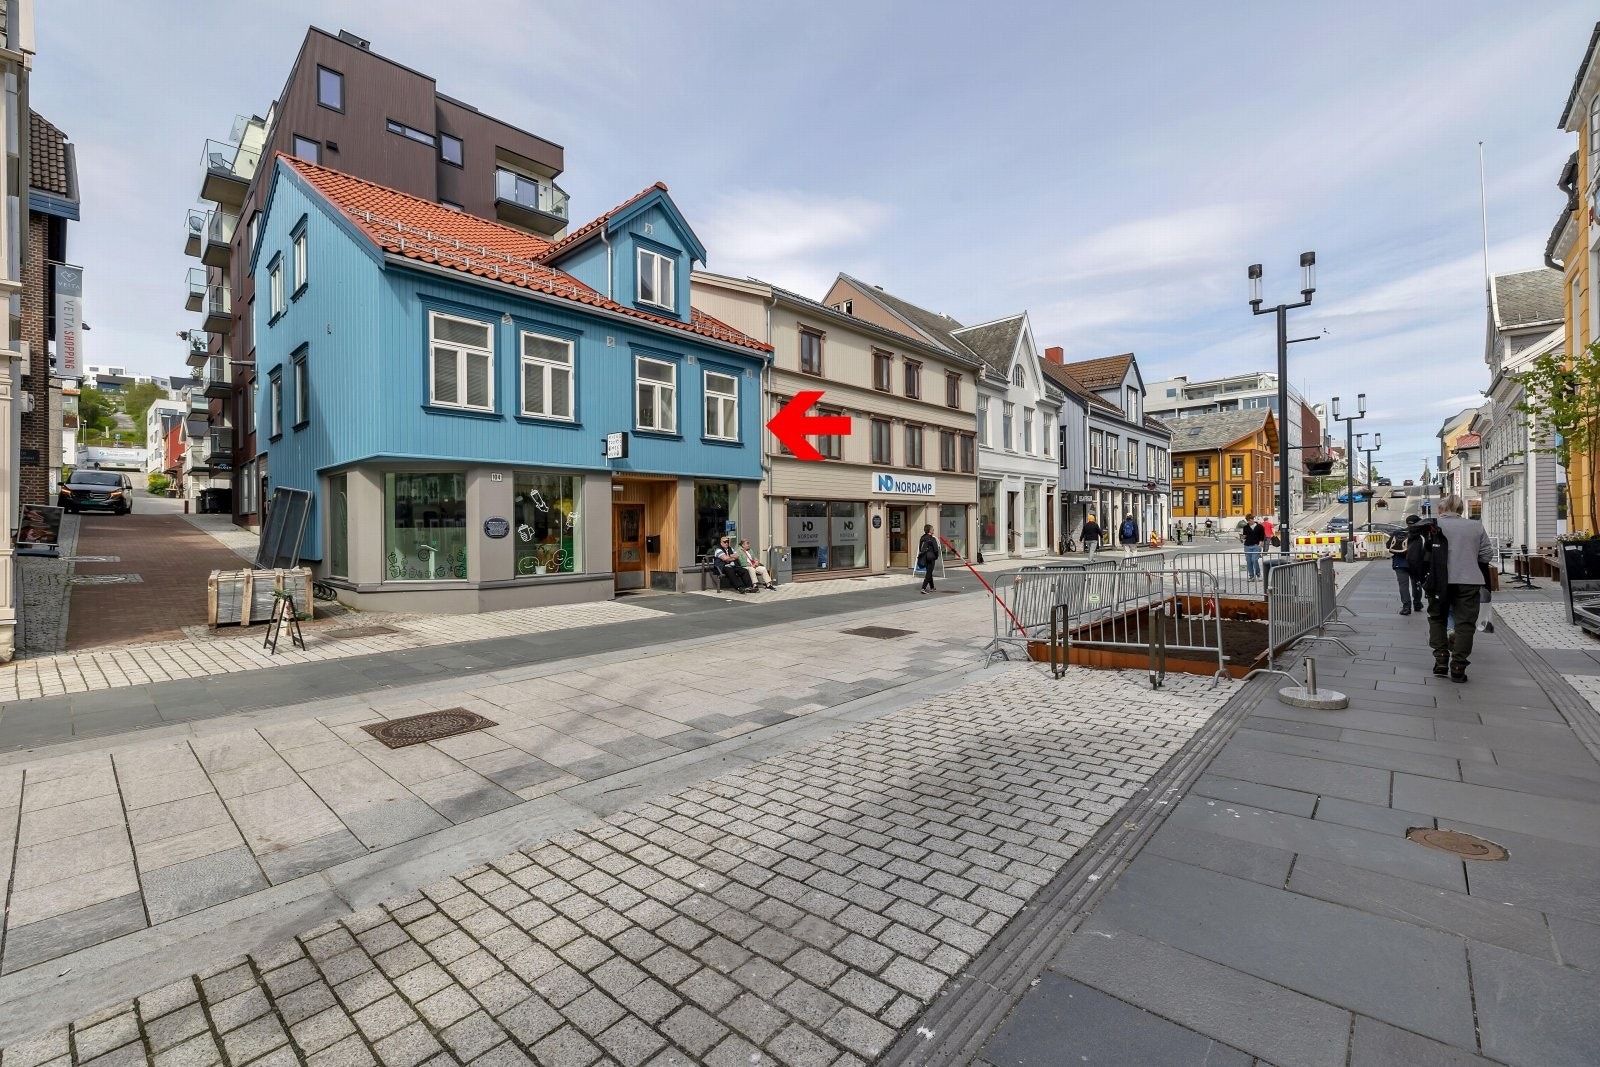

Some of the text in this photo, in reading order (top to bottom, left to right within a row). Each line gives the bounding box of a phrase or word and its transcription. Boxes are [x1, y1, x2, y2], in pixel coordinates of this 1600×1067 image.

[58, 281, 80, 289] VEITA
[64, 300, 75, 369] VEITA SHOPPING
[895, 481, 932, 494] NORDAMP
